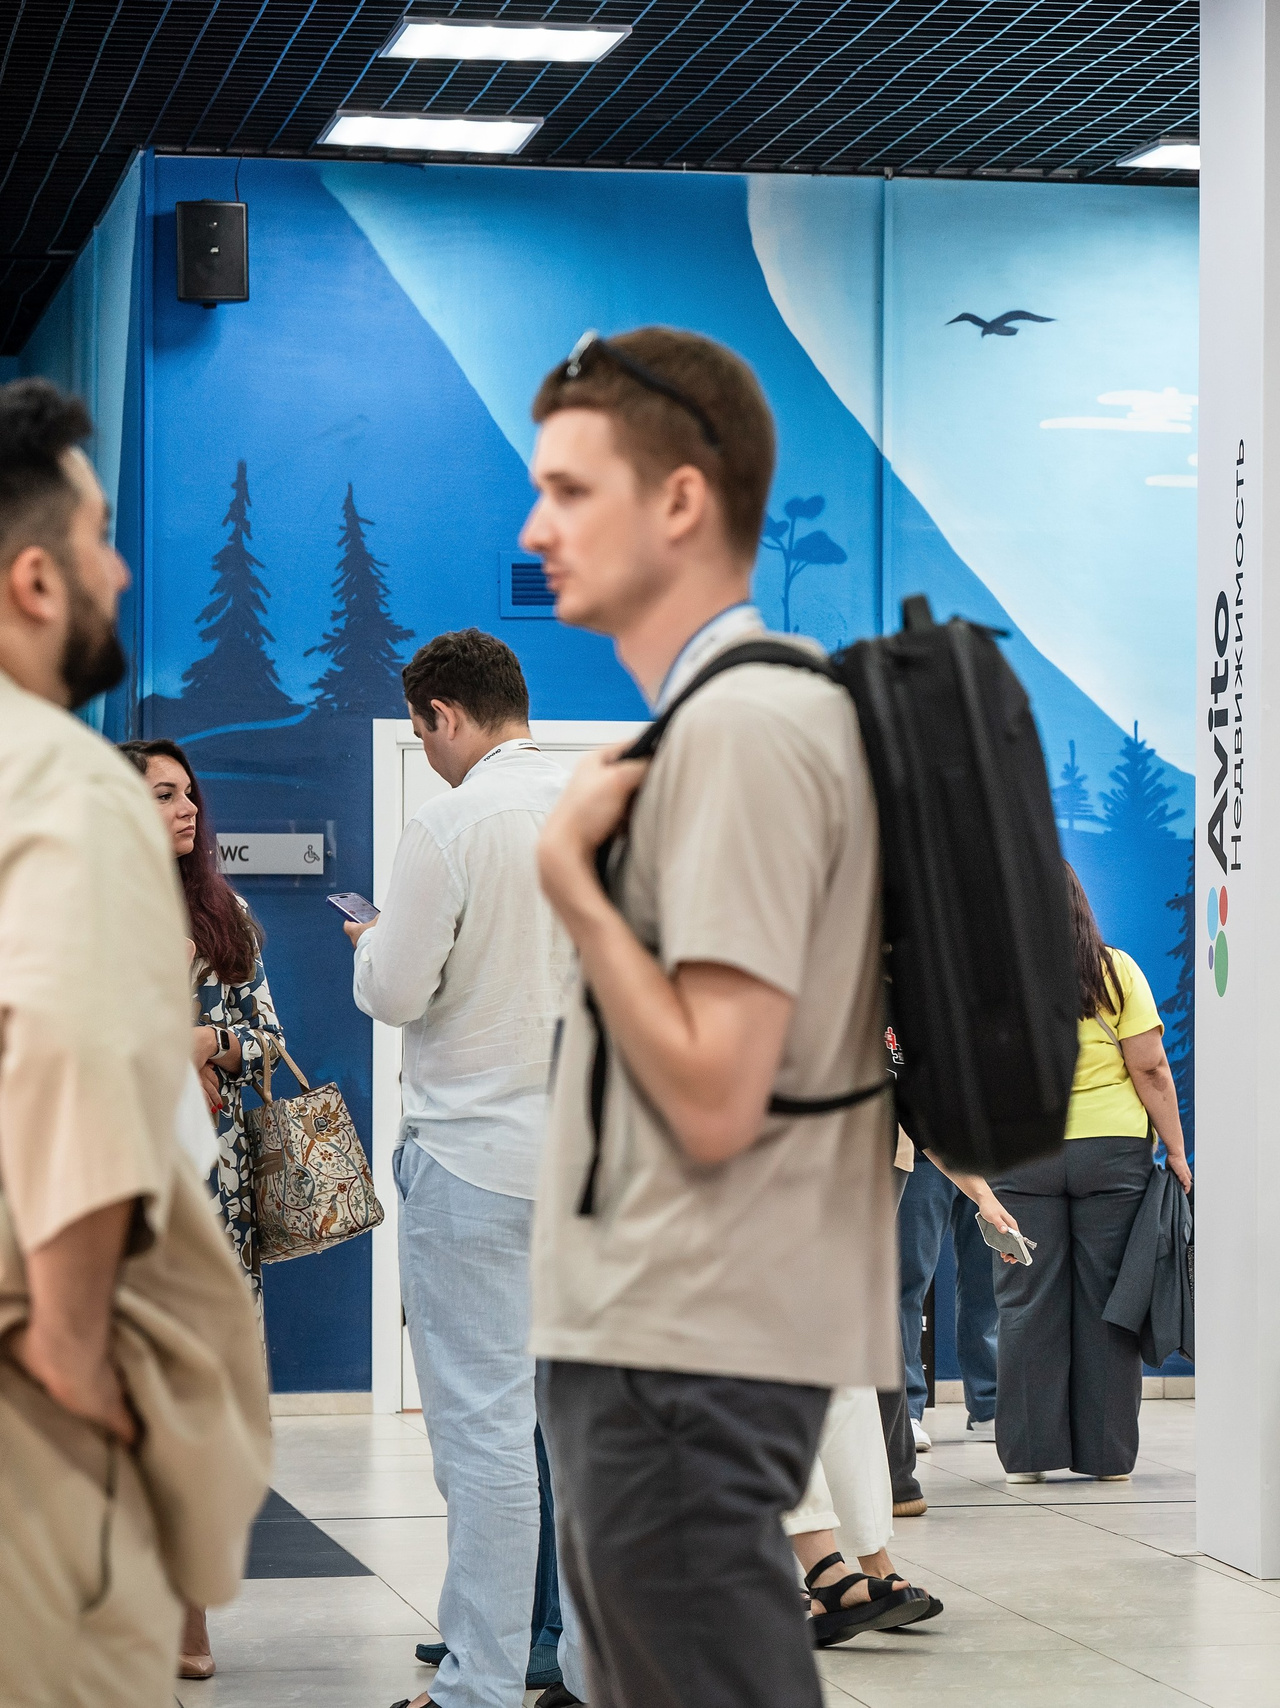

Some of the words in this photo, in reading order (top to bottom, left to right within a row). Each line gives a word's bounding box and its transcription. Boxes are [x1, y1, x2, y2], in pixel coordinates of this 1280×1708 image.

[1207, 590, 1231, 876] Avito
[1230, 438, 1245, 871] Недвижимость
[220, 845, 249, 862] WC
